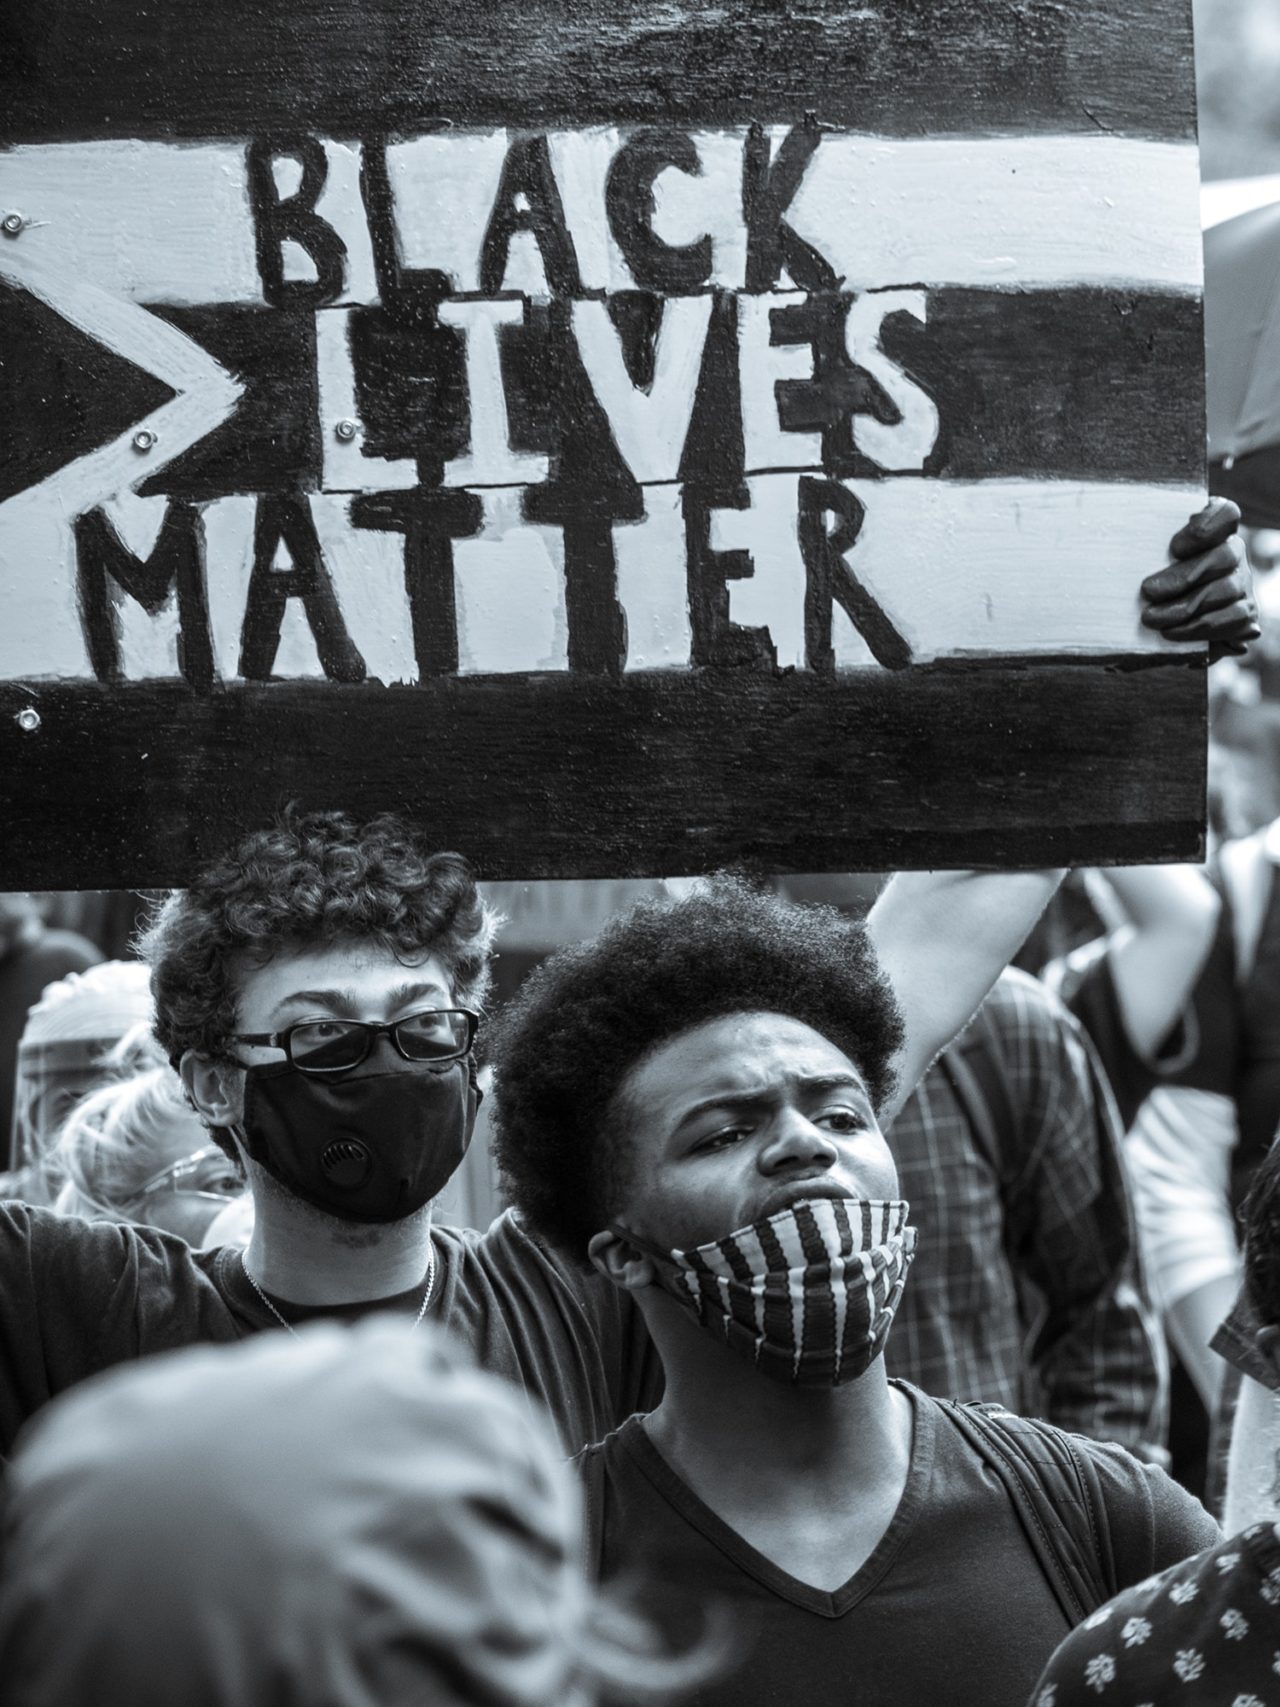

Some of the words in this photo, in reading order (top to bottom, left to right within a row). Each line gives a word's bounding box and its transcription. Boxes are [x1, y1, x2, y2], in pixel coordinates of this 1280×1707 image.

[245, 120, 846, 308] BLACK
[315, 290, 941, 492] LIVES
[74, 478, 914, 688] MATTER
